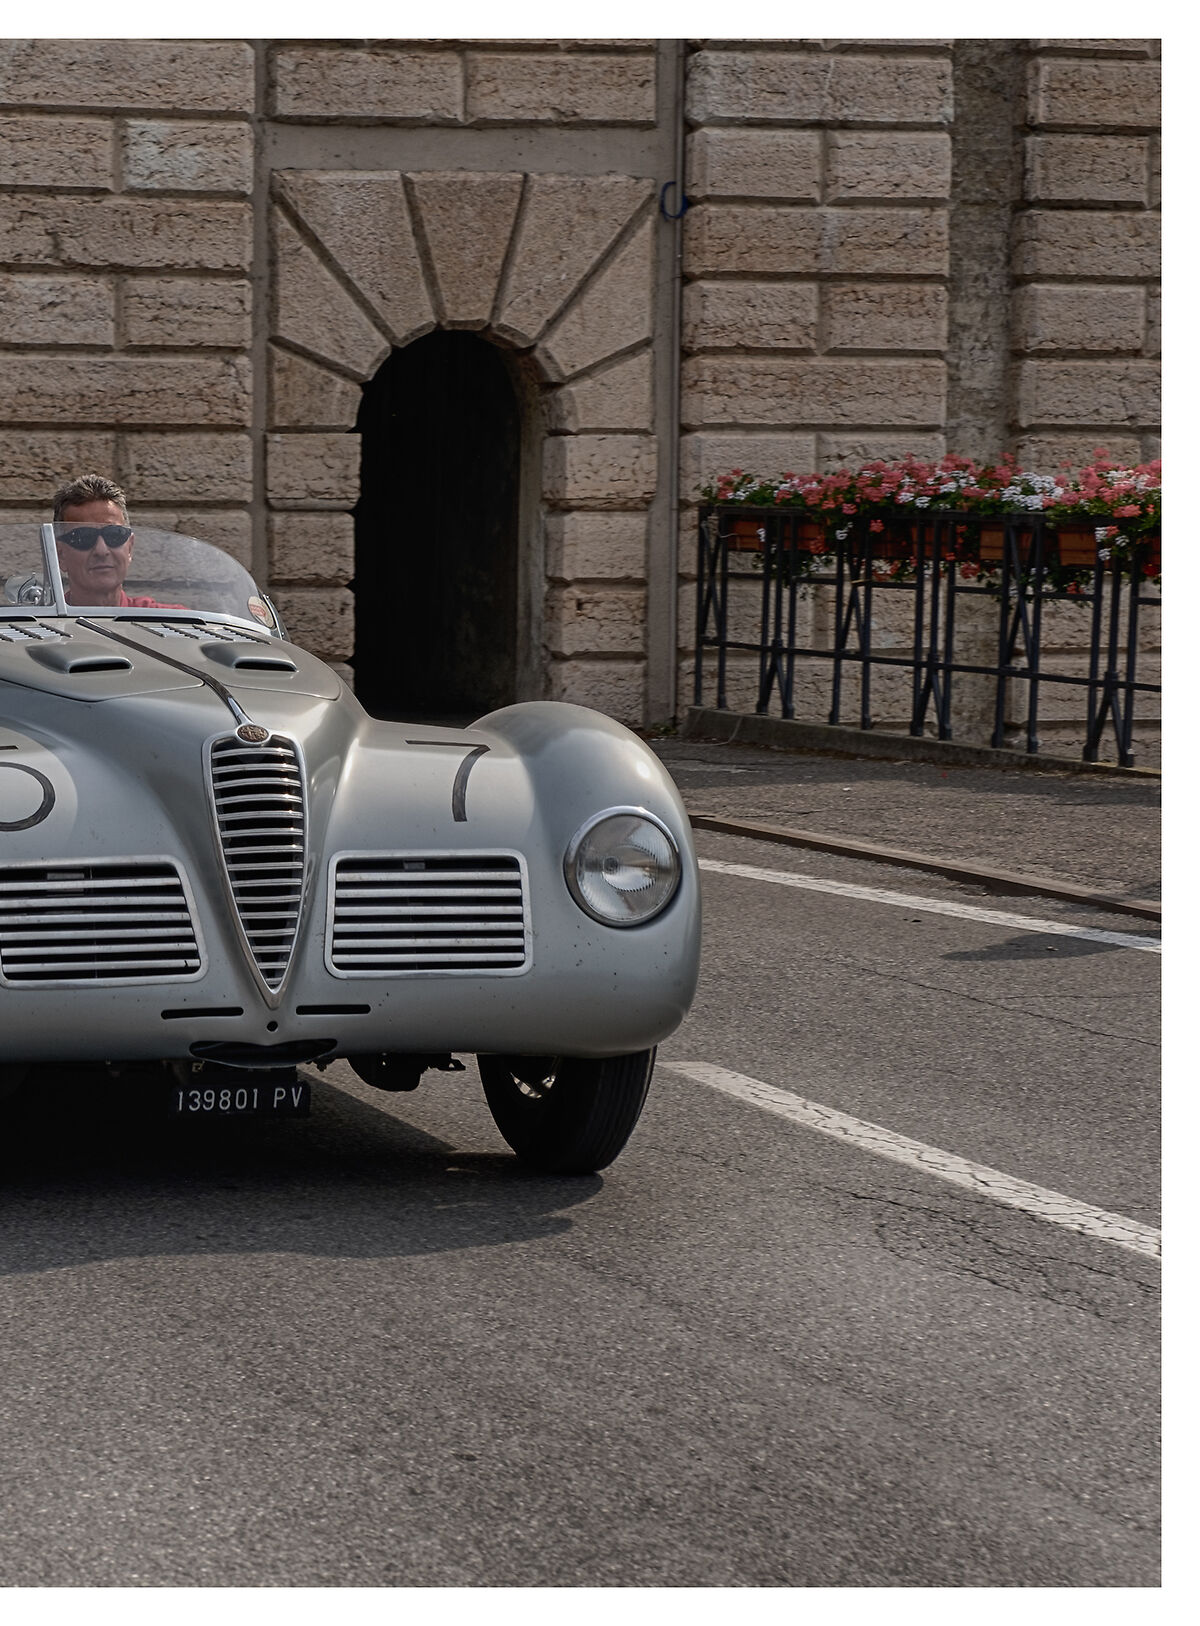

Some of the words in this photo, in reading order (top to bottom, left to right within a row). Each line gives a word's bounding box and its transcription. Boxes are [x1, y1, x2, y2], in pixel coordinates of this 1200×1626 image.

[405, 740, 491, 823] 7
[178, 1088, 258, 1112] 139801
[273, 1086, 302, 1109] PV
